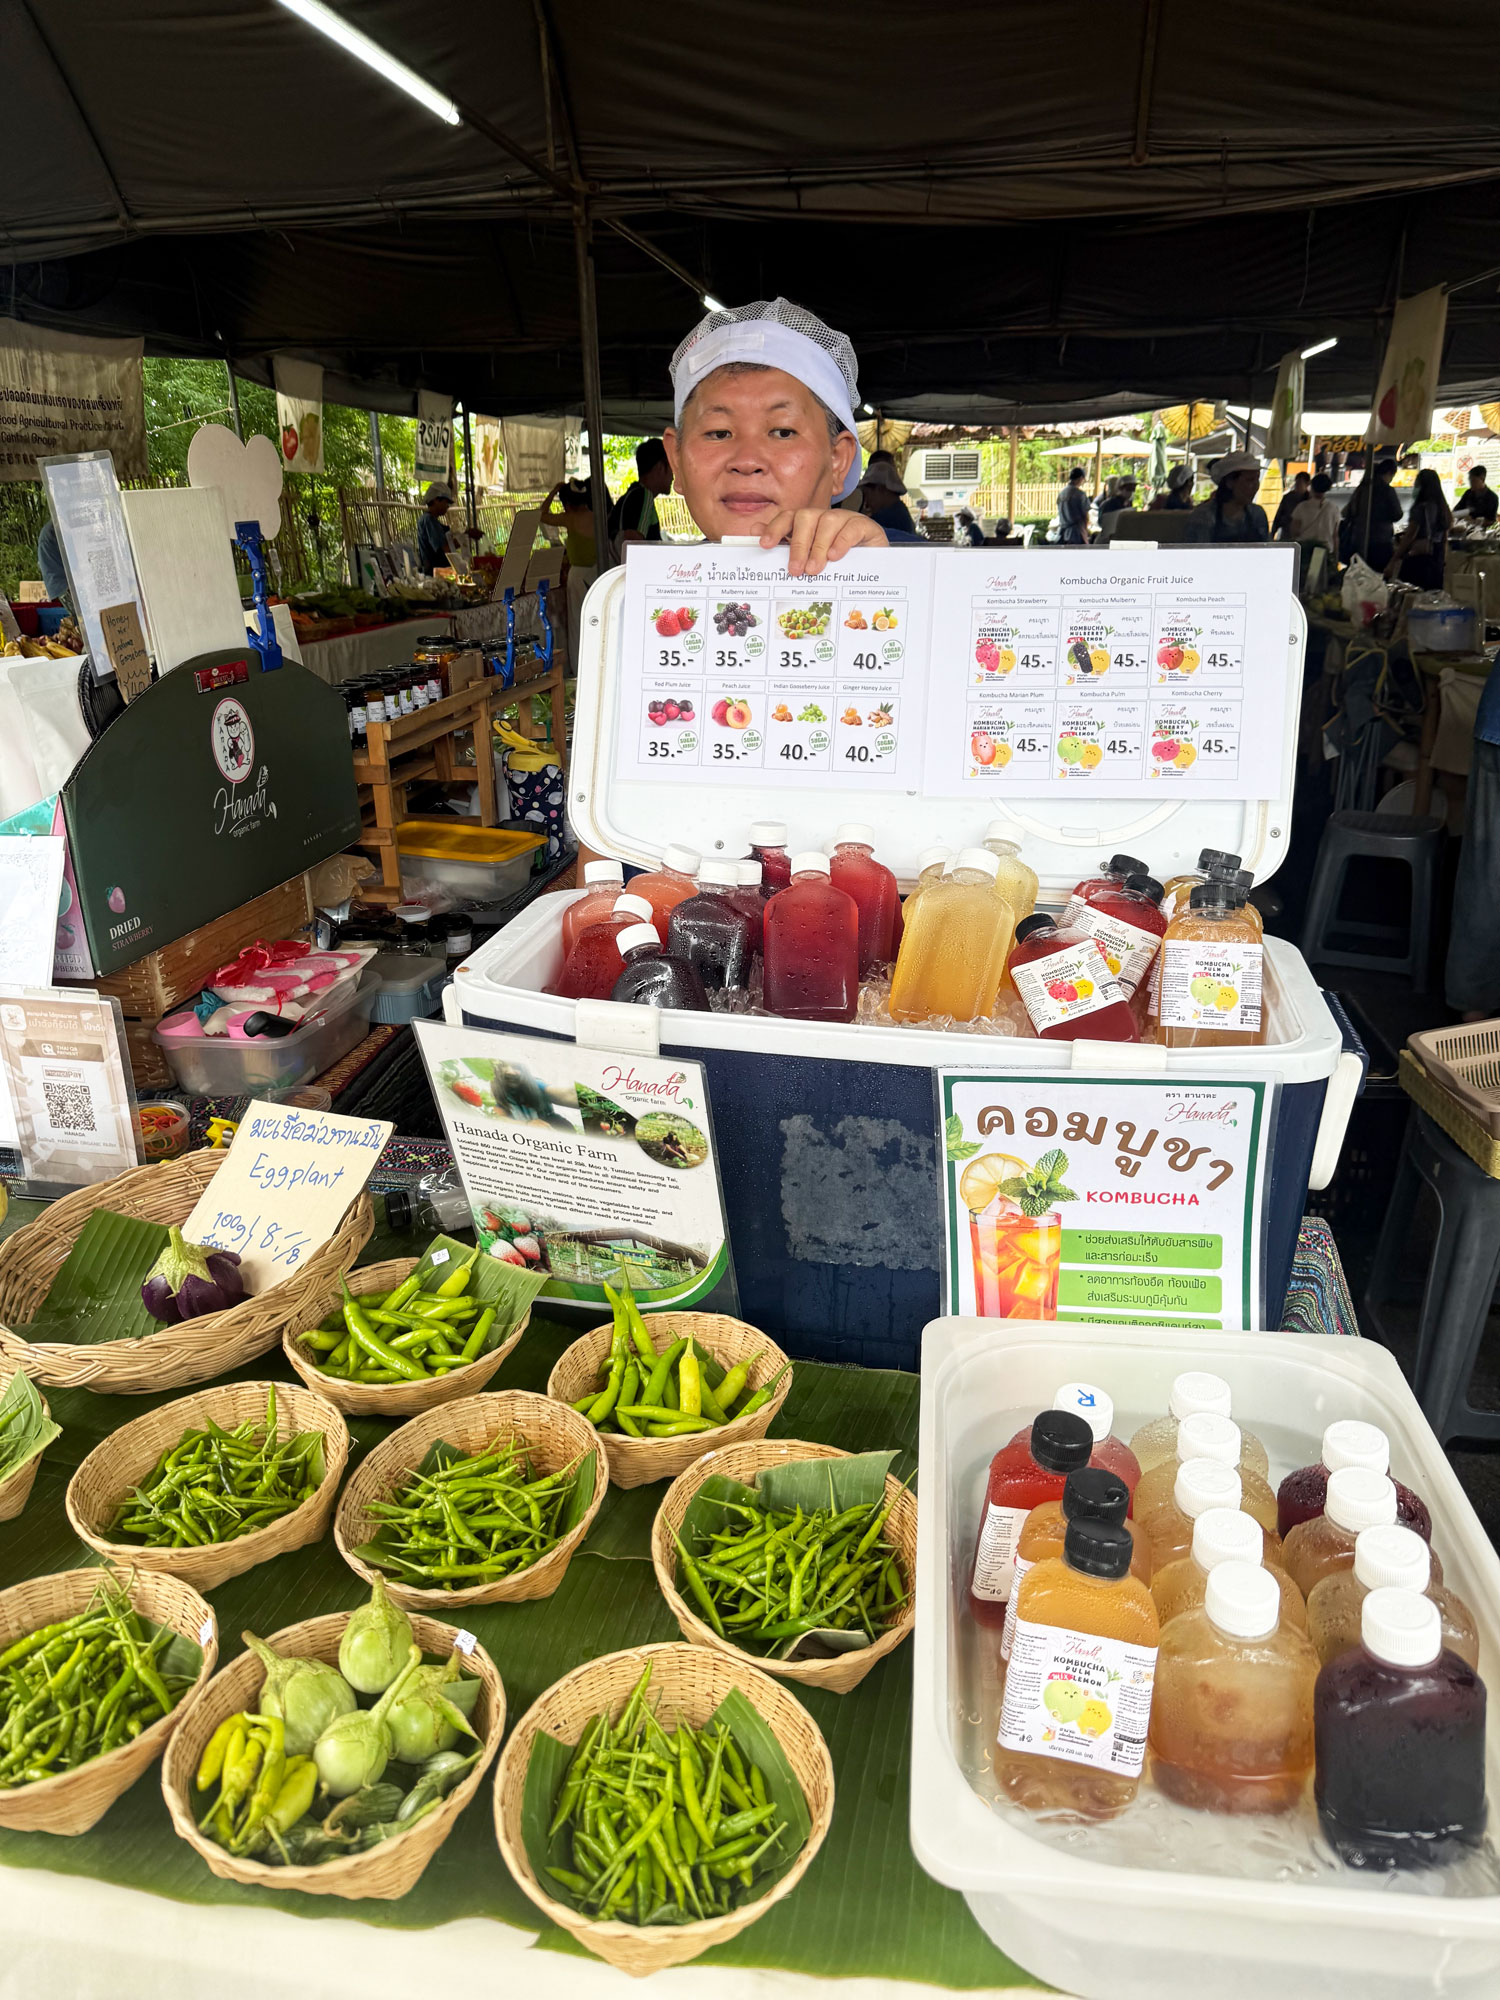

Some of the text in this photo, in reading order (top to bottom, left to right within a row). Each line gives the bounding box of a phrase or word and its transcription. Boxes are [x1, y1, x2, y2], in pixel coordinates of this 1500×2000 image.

[19, 415, 68, 430] Agricultural
[70, 419, 104, 432] Practice
[31, 433, 57, 447] Group
[796, 573, 831, 583] Organic
[834, 573, 854, 582] Fruit
[857, 573, 879, 582] Juice
[1060, 576, 1194, 586] Kombucha Organic Fruit Juice
[656, 588, 683, 596] Strawberry
[1110, 597, 1136, 605] Mulberry
[106, 614, 130, 630] Honey
[659, 650, 694, 667] 35.-
[715, 650, 751, 667] 35.-
[780, 651, 816, 668] 35.-
[853, 653, 890, 670] 40.-
[1021, 654, 1053, 668] 45.-
[1114, 653, 1146, 668] 45.-
[1208, 653, 1241, 668] 45.-
[648, 742, 683, 757] 35.-
[713, 744, 748, 760] 35.-
[780, 744, 816, 760] 40.-
[1017, 738, 1048, 753] 45.-
[1107, 740, 1140, 754] 45.-
[1202, 739, 1236, 753] 45.-
[845, 746, 882, 762] 40.-
[213, 783, 272, 835] Hanada
[232, 819, 261, 838] organic farm
[109, 916, 141, 940] DRIED
[112, 925, 154, 951] STRAWBERRY
[1094, 933, 1124, 948] STRAWBERRY
[1097, 929, 1127, 944] KOMBUCHA
[55, 954, 82, 964] RIED
[1041, 964, 1073, 978] KOMBUCHA
[1043, 968, 1075, 981] STRAWBERRY
[601, 1065, 690, 1104] Hanada
[625, 1095, 667, 1106] organic farm
[1165, 1101, 1230, 1125] Hanada
[453, 1121, 618, 1162] Hanada Organic Farm
[976, 1105, 1234, 1192] คอมบูชา
[249, 1152, 345, 1190] Eggplant
[508, 1154, 528, 1163] Chiang
[555, 1164, 577, 1172] organic
[610, 1173, 637, 1183] chemical
[610, 1167, 634, 1175] Tumbon
[636, 1171, 664, 1181] Samoeng
[1086, 1190, 1200, 1207] KOMBUCHA
[1085, 1251, 1158, 1263] และสารก่อมะเร็ง
[1087, 1274, 1207, 1290] ลดอาการท้องอืด ท้องเฟ้อ
[1087, 1291, 1188, 1308] ส่งเสริมระบบภูมิคุ้มกัน
[1077, 1389, 1097, 1406] R
[1053, 1655, 1105, 1673] KOMBUCHA
[1065, 1666, 1091, 1676] PULM
[1052, 1672, 1102, 1687] MIX LEMON
